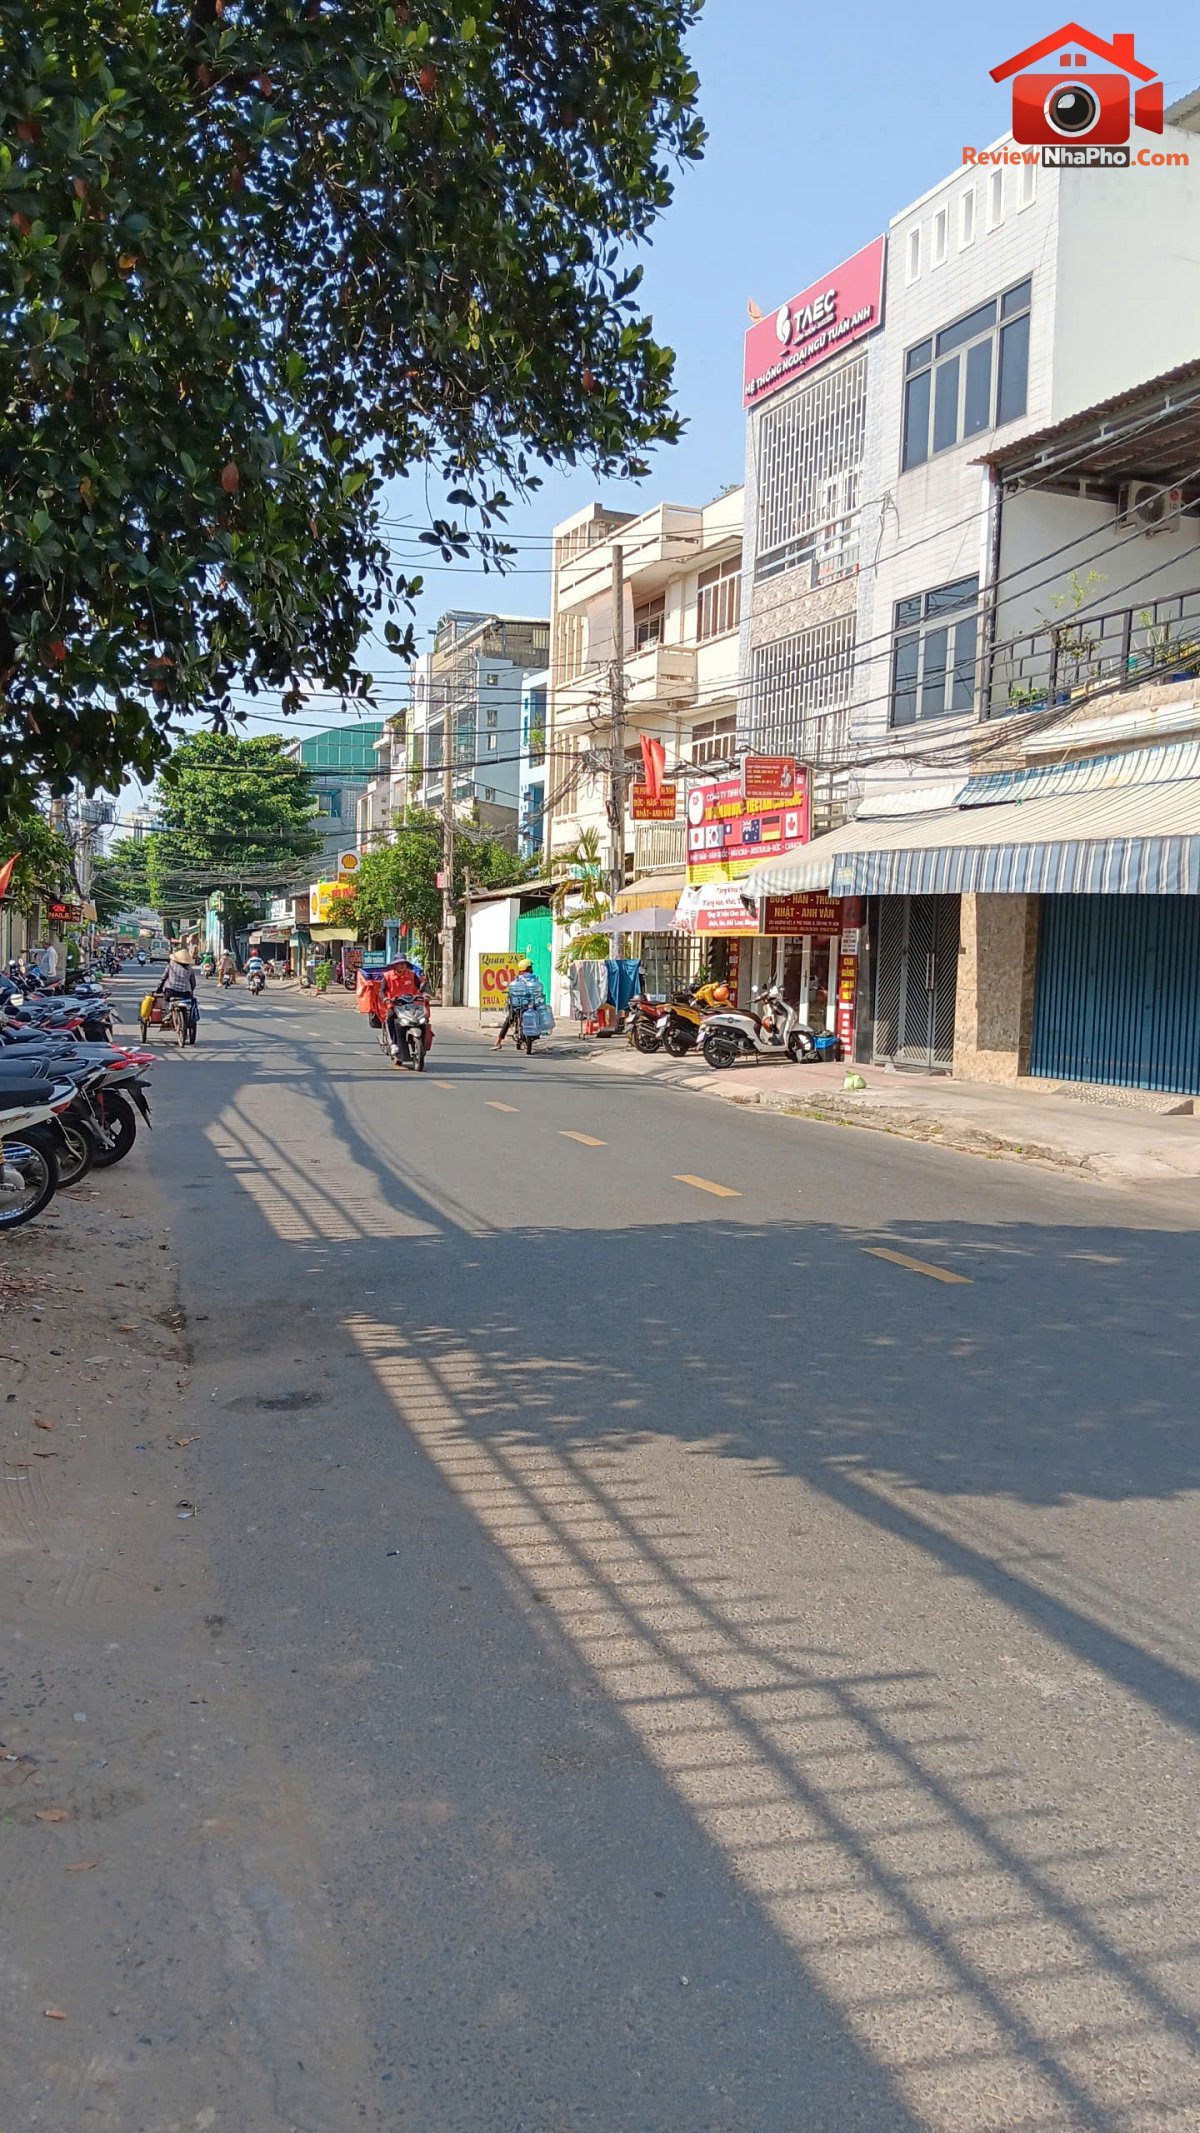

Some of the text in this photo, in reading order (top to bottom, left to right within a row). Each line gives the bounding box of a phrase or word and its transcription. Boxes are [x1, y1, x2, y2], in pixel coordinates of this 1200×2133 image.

[793, 289, 836, 330] TAEC
[745, 377, 756, 394] HỆ
[782, 346, 807, 371] NGOẠI
[850, 306, 871, 327] ANH
[774, 905, 835, 919] NHẬT ANH VĂN
